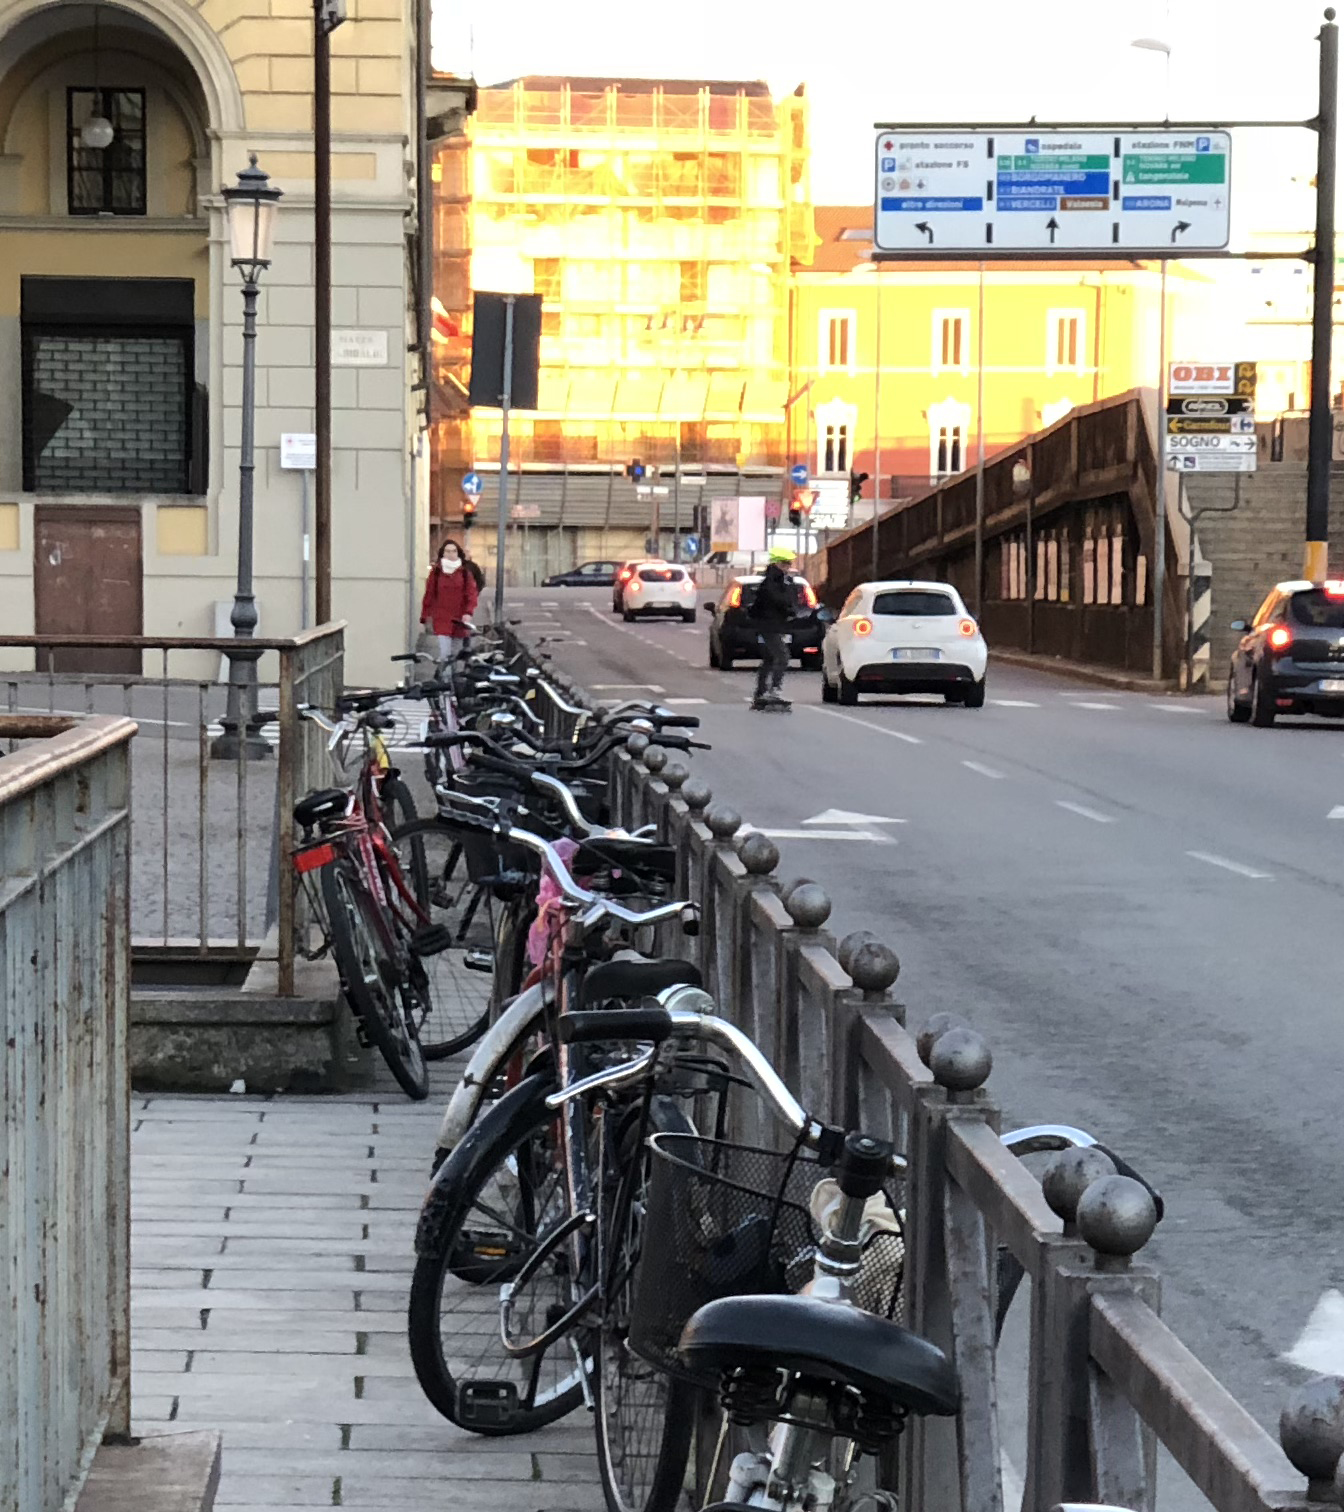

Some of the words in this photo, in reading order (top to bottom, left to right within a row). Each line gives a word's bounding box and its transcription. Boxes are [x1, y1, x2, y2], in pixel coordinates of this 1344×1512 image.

[1132, 141, 1169, 149] stazione
[915, 161, 953, 169] stazione
[1172, 366, 1231, 381] OBI
[1170, 436, 1220, 448] SOGNO
